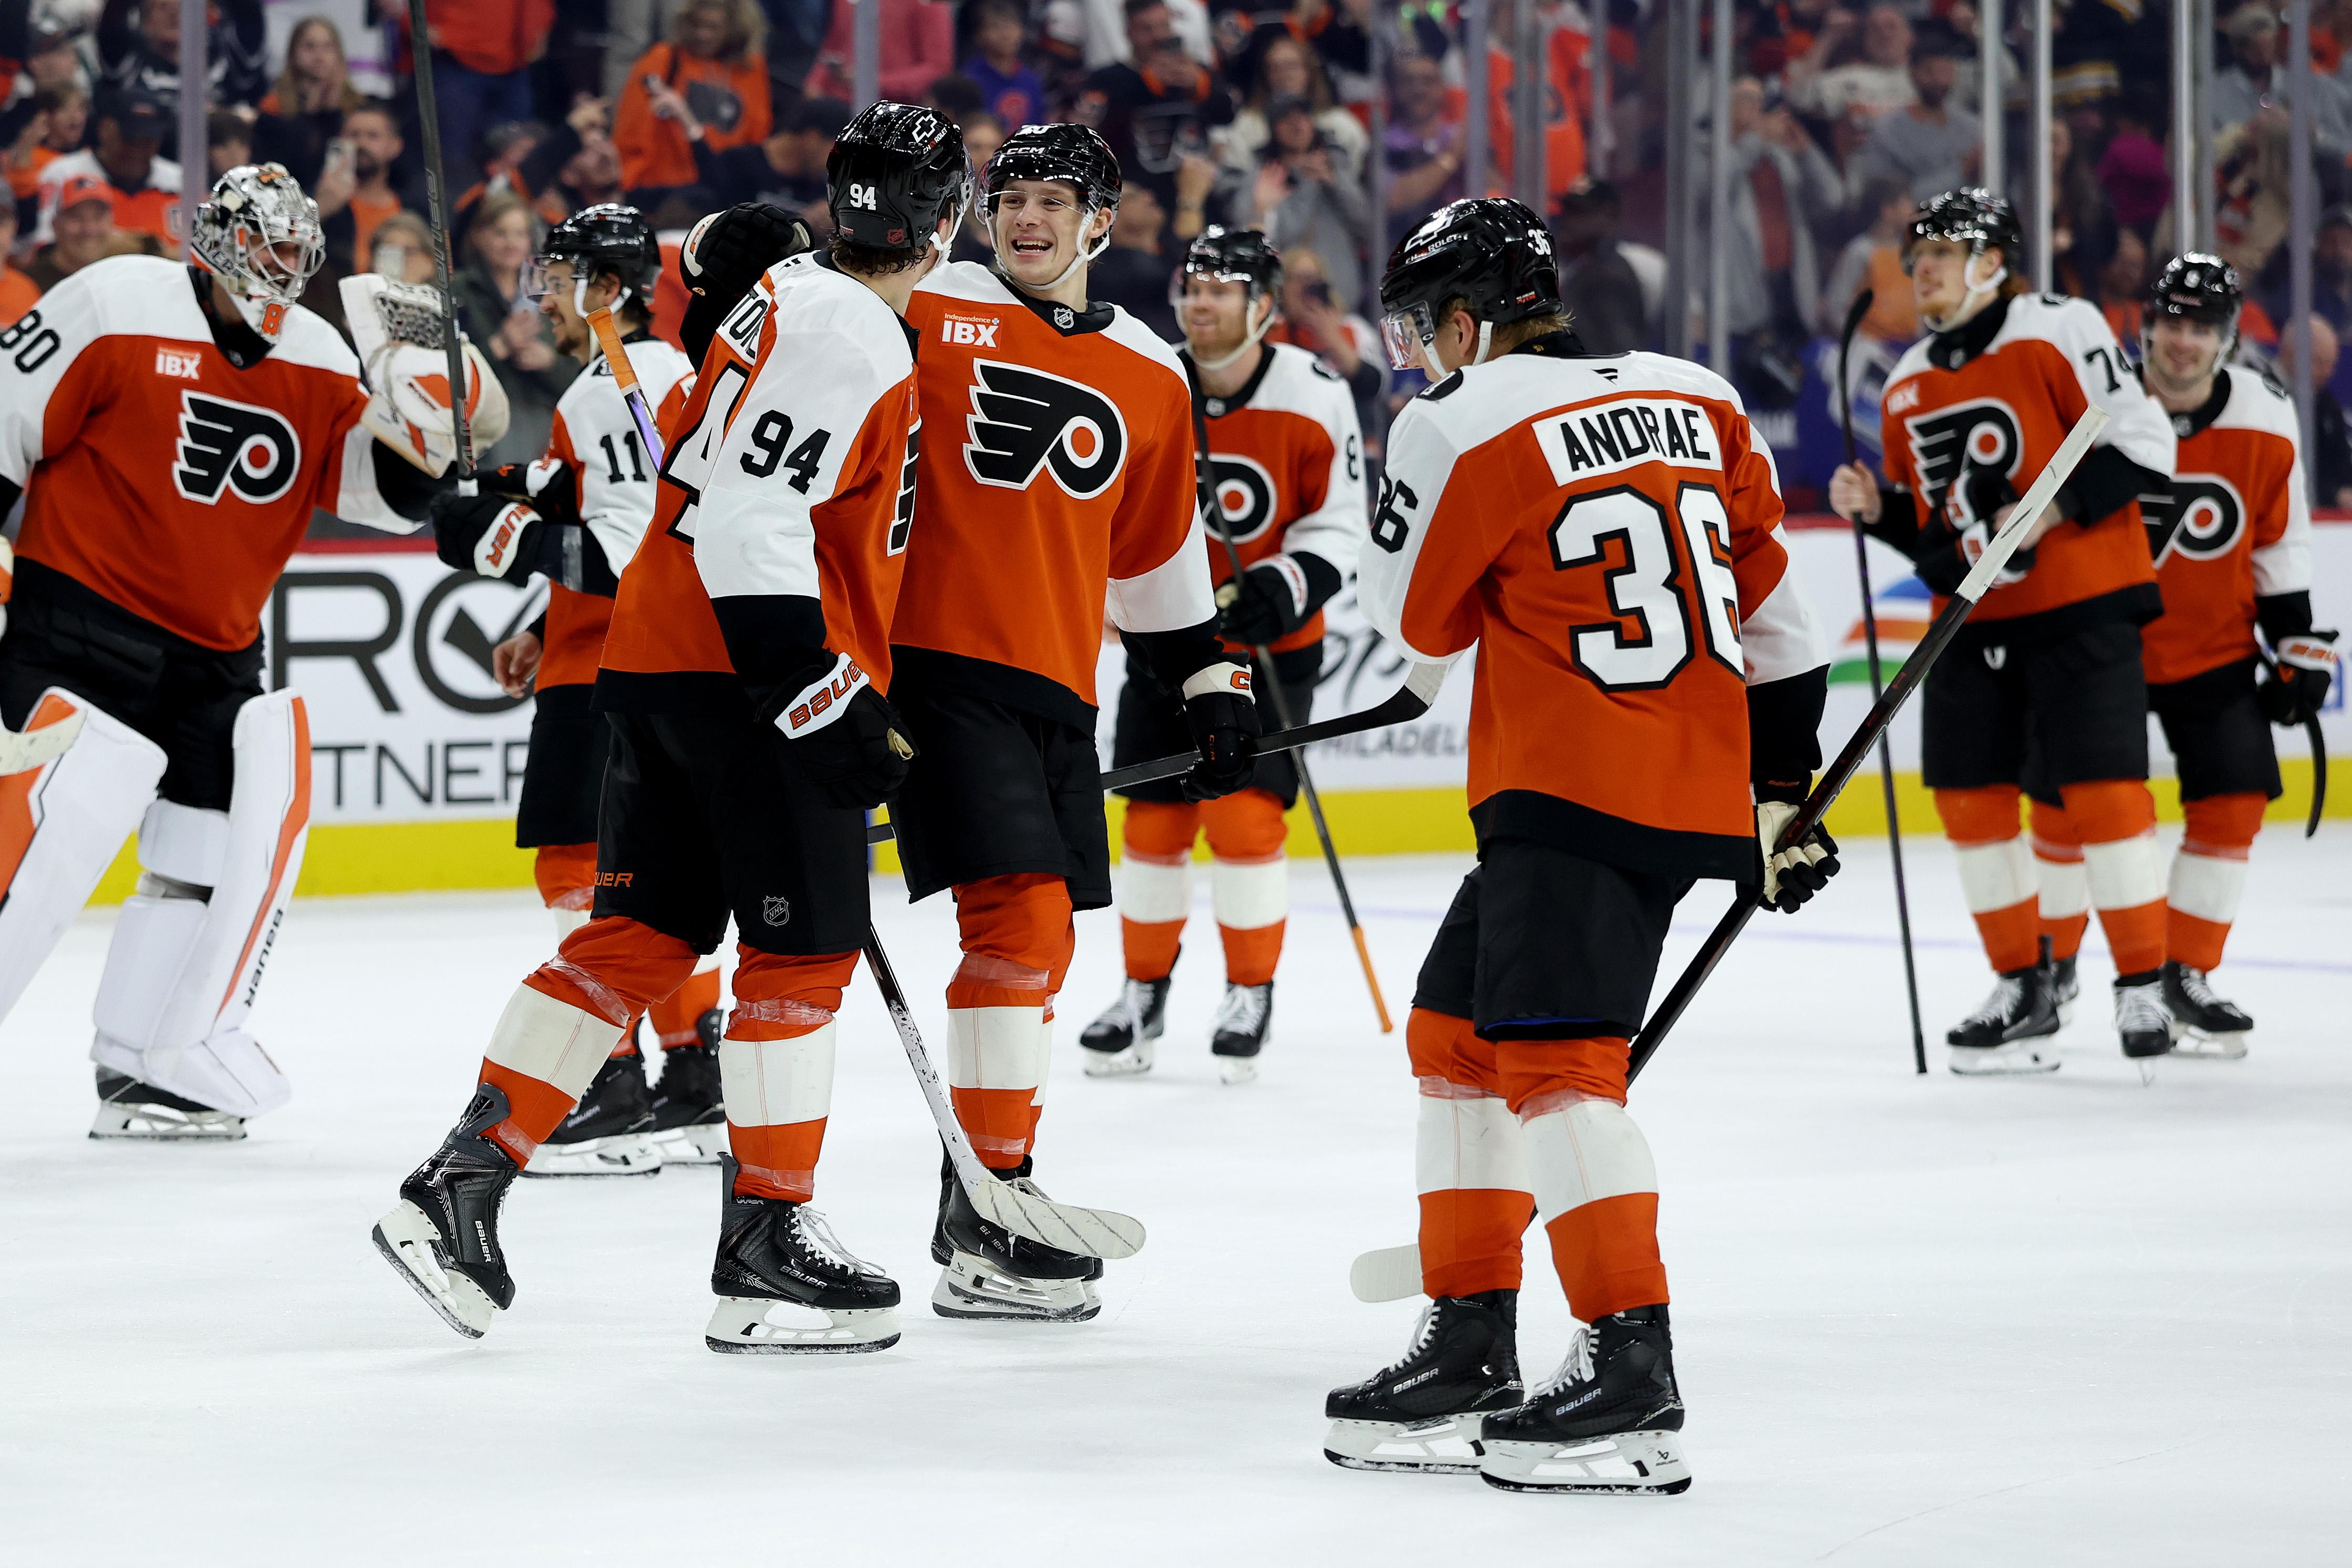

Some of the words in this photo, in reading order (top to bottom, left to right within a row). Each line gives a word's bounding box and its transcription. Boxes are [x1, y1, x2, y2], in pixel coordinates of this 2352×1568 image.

[849, 183, 876, 211] 94
[1528, 229, 1551, 256] 36
[944, 313, 991, 324] Independence
[0, 309, 60, 373] 80
[941, 320, 998, 348] IBX
[156, 352, 201, 380] IBX
[740, 409, 831, 495] 94
[1560, 406, 1711, 472] ANDRAE
[600, 430, 647, 483] 11
[1547, 481, 1745, 693] 36
[789, 660, 863, 730] BAUE
[475, 1220, 492, 1262] BAUER
[779, 1264, 828, 1290] BAUER
[1393, 1367, 1439, 1395] BAUER
[1556, 1387, 1602, 1417] BAUER
